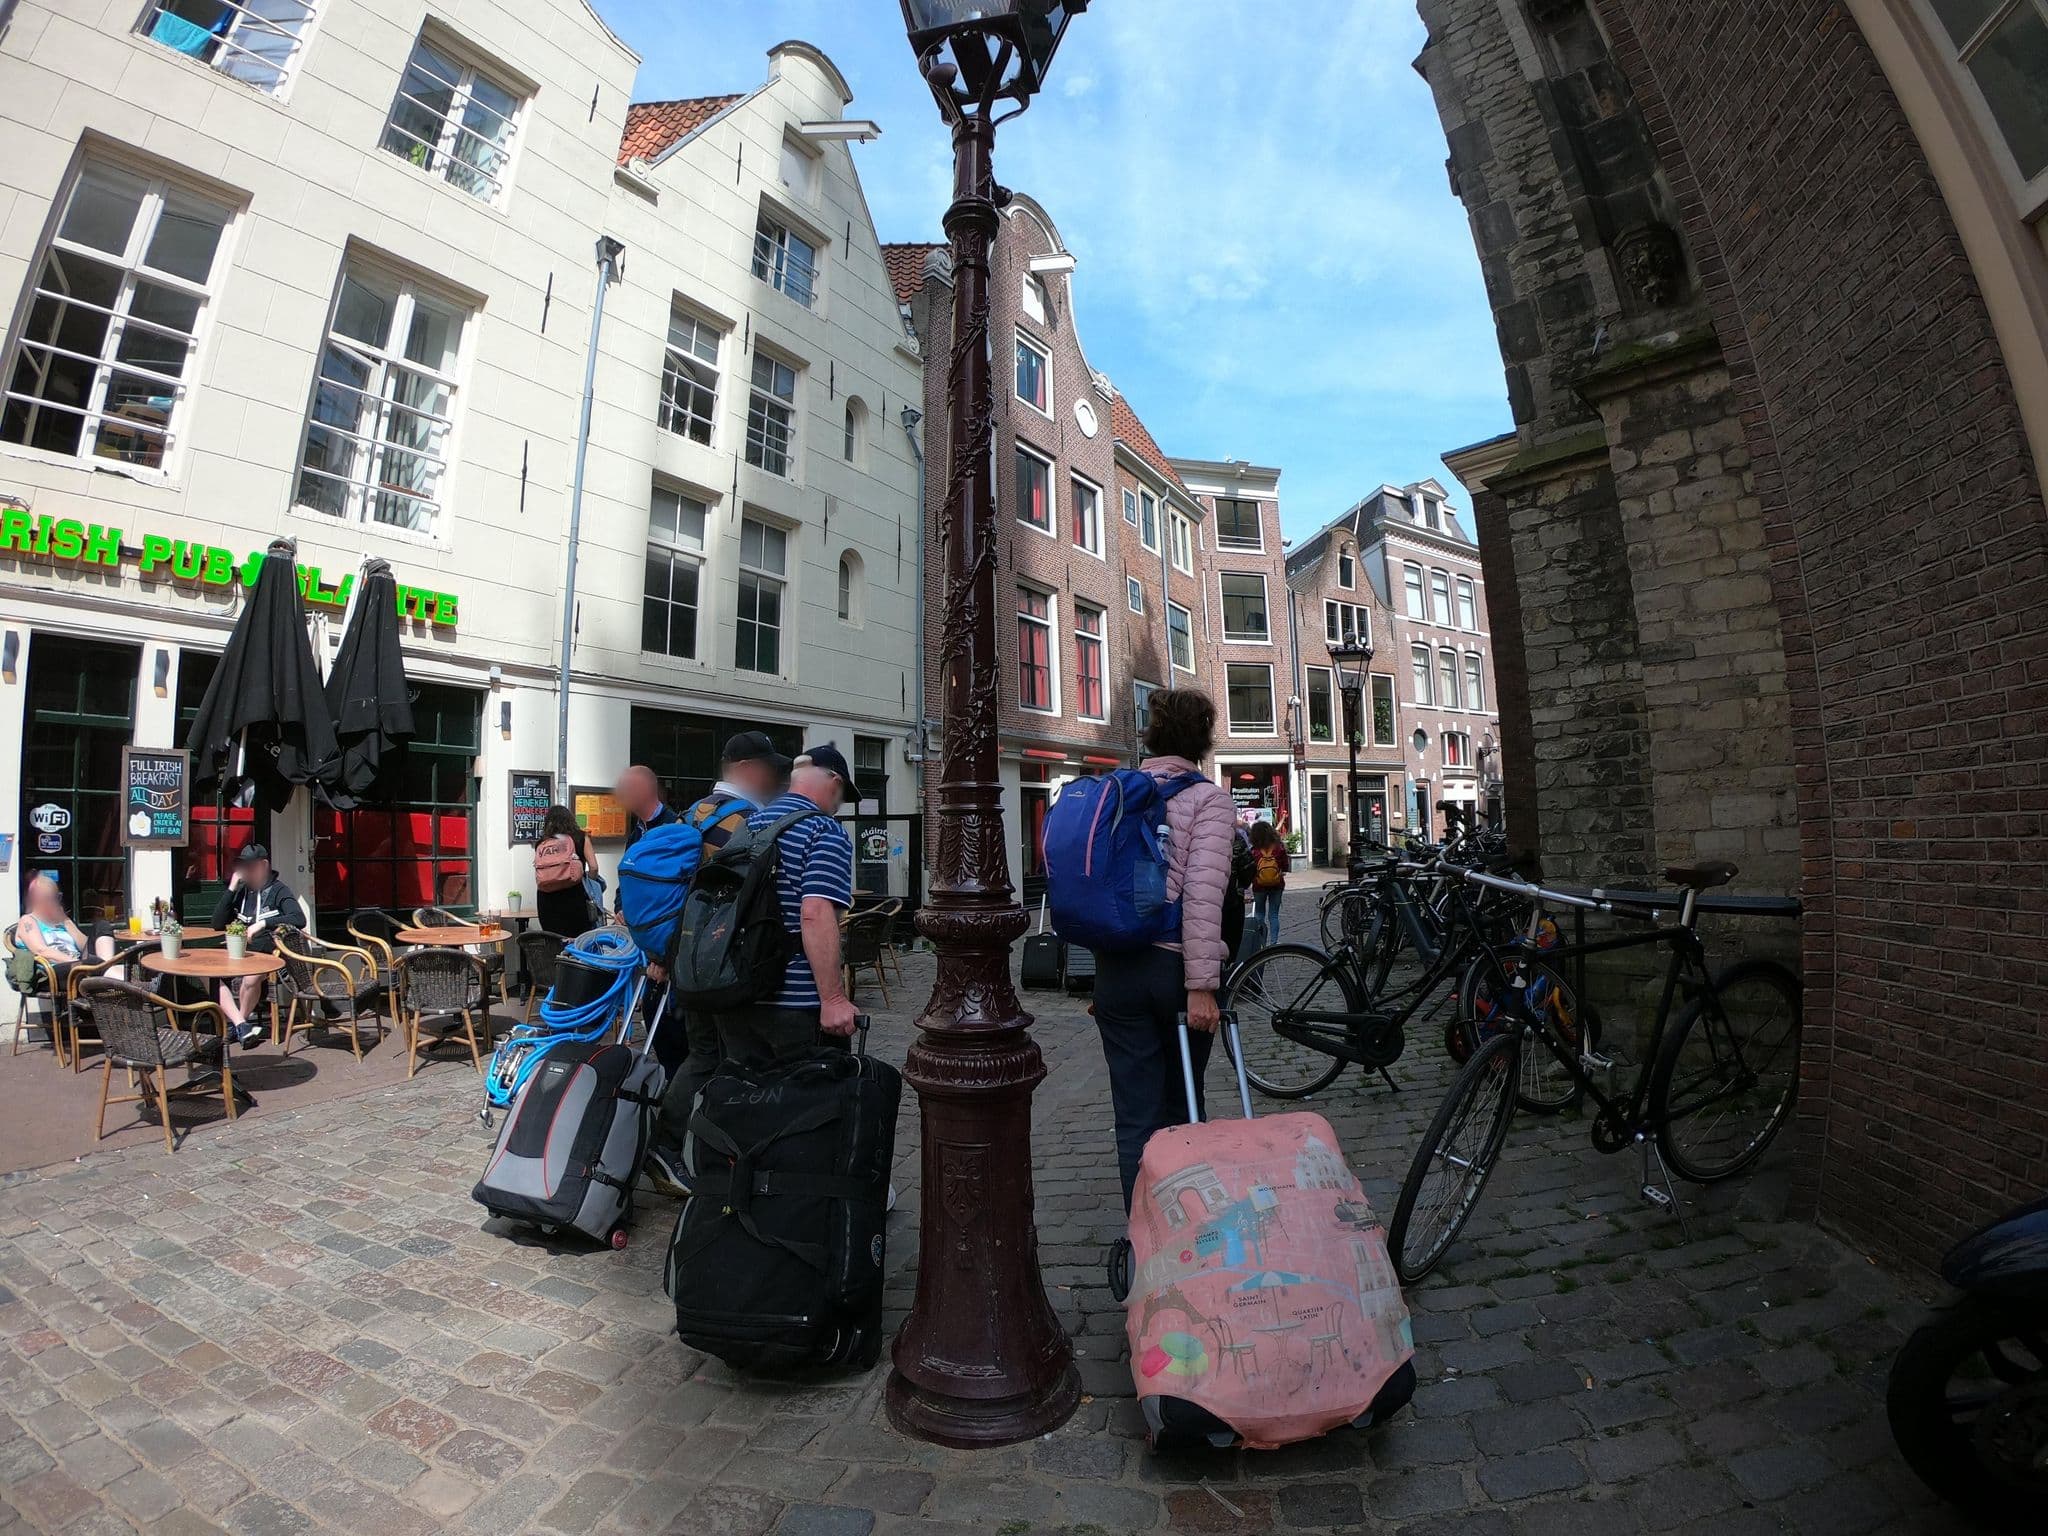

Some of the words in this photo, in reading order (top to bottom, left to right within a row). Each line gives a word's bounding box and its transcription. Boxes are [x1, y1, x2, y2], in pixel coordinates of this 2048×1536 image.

[0, 508, 124, 567] RISH
[139, 533, 235, 586] PUB
[130, 760, 153, 772] FULL
[153, 760, 182, 773] IRISH
[130, 772, 182, 787] BREAKFAST
[533, 788, 549, 797] DEAL
[131, 788, 148, 802] ALL
[151, 793, 175, 807] DAY
[514, 798, 549, 807] HEINEKEN
[153, 812, 178, 821] PLEASE
[153, 827, 167, 835] THE
[167, 827, 181, 835] BAR
[1233, 1300, 1266, 1308] GERMAIN
[1292, 1306, 1324, 1316] QUARTIER
[1299, 1313, 1319, 1321] LATIN
